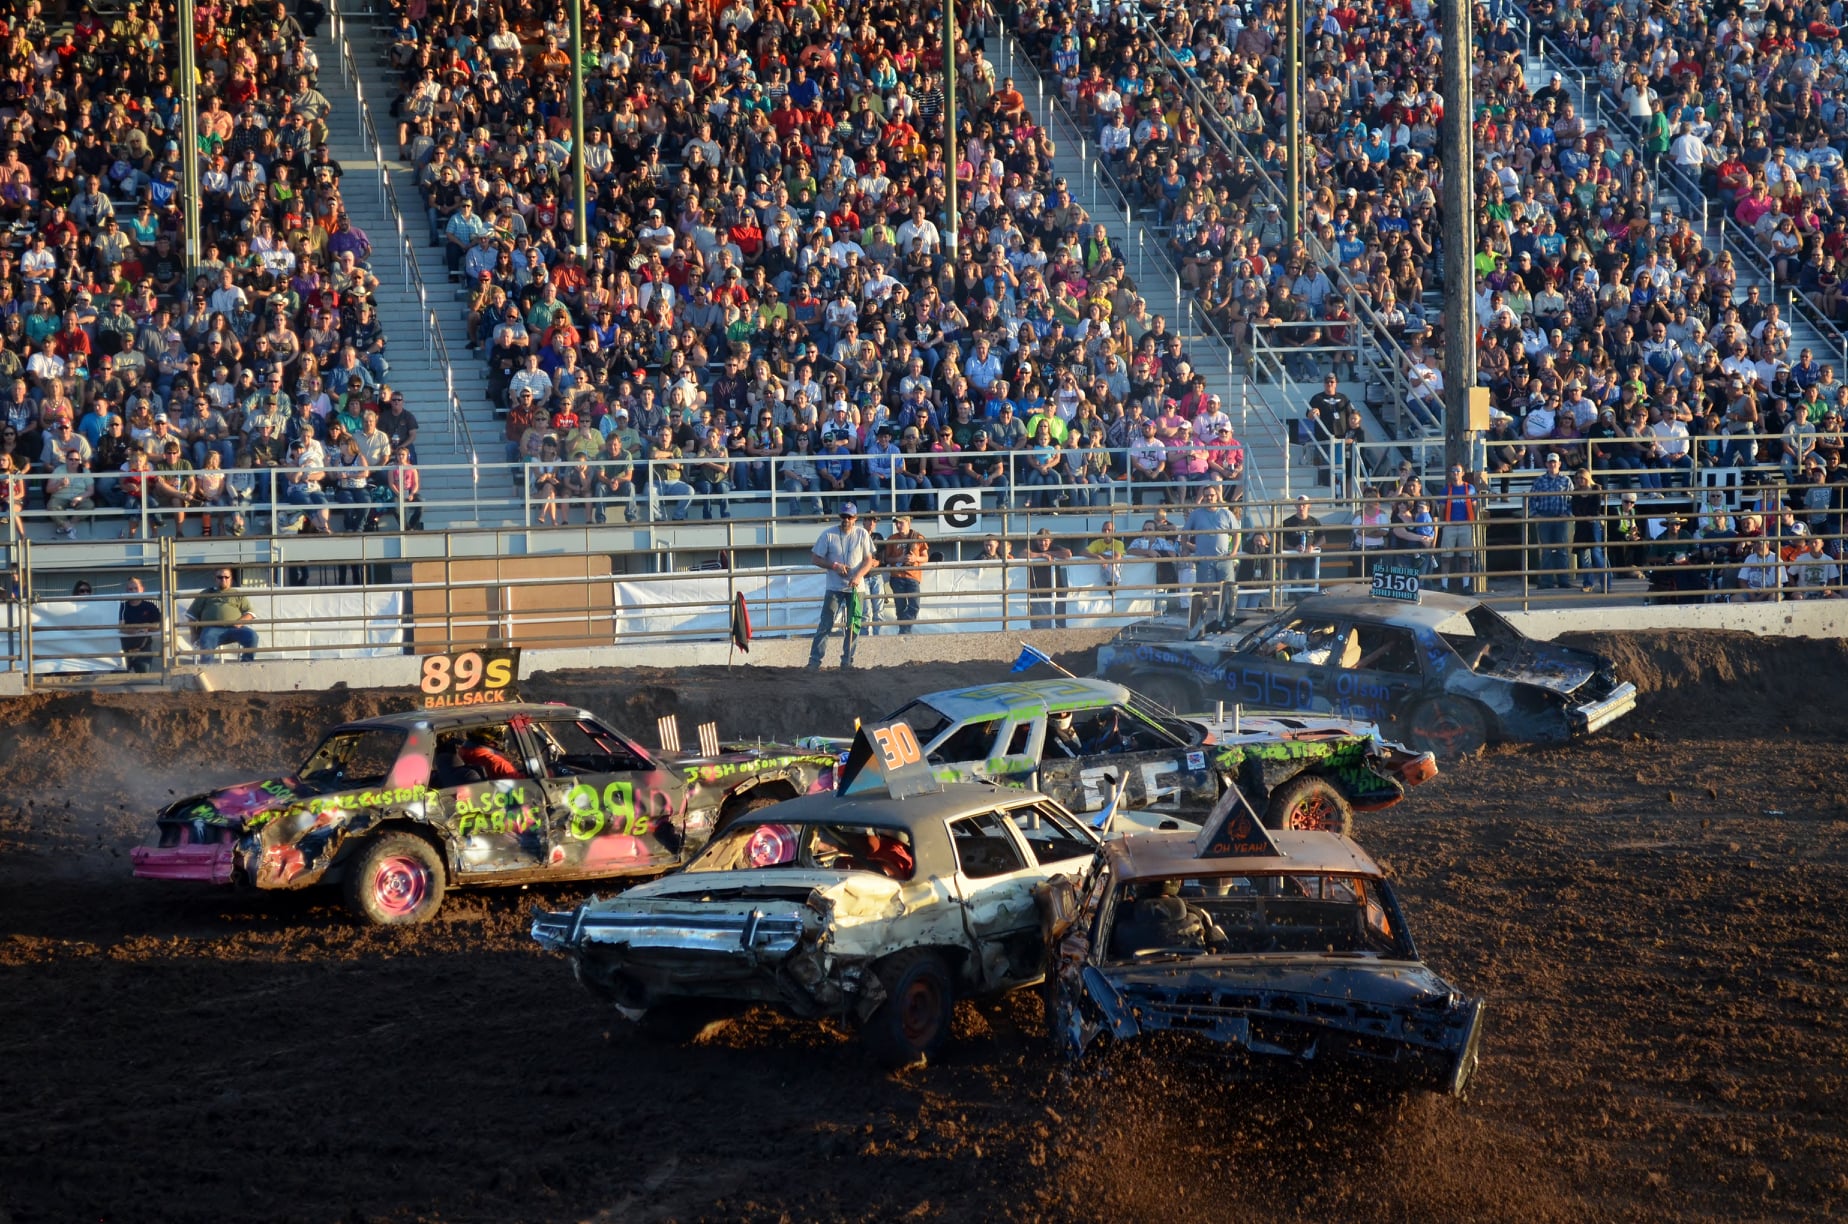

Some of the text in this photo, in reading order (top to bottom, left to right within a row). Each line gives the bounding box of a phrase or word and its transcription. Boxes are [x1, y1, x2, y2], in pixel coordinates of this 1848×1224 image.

[943, 493, 977, 528] G
[1372, 572, 1419, 593] 5150
[1136, 645, 1180, 664] Olson
[424, 690, 505, 708] BALLSACK
[1243, 668, 1313, 710] 5150
[1336, 673, 1390, 701] Olson
[873, 722, 921, 771] 30
[683, 763, 736, 783] JOSH
[739, 758, 777, 772] OLSON
[456, 786, 525, 815] OLSON
[459, 806, 542, 837] FARMS
[1212, 841, 1268, 854] OH YEAH!
